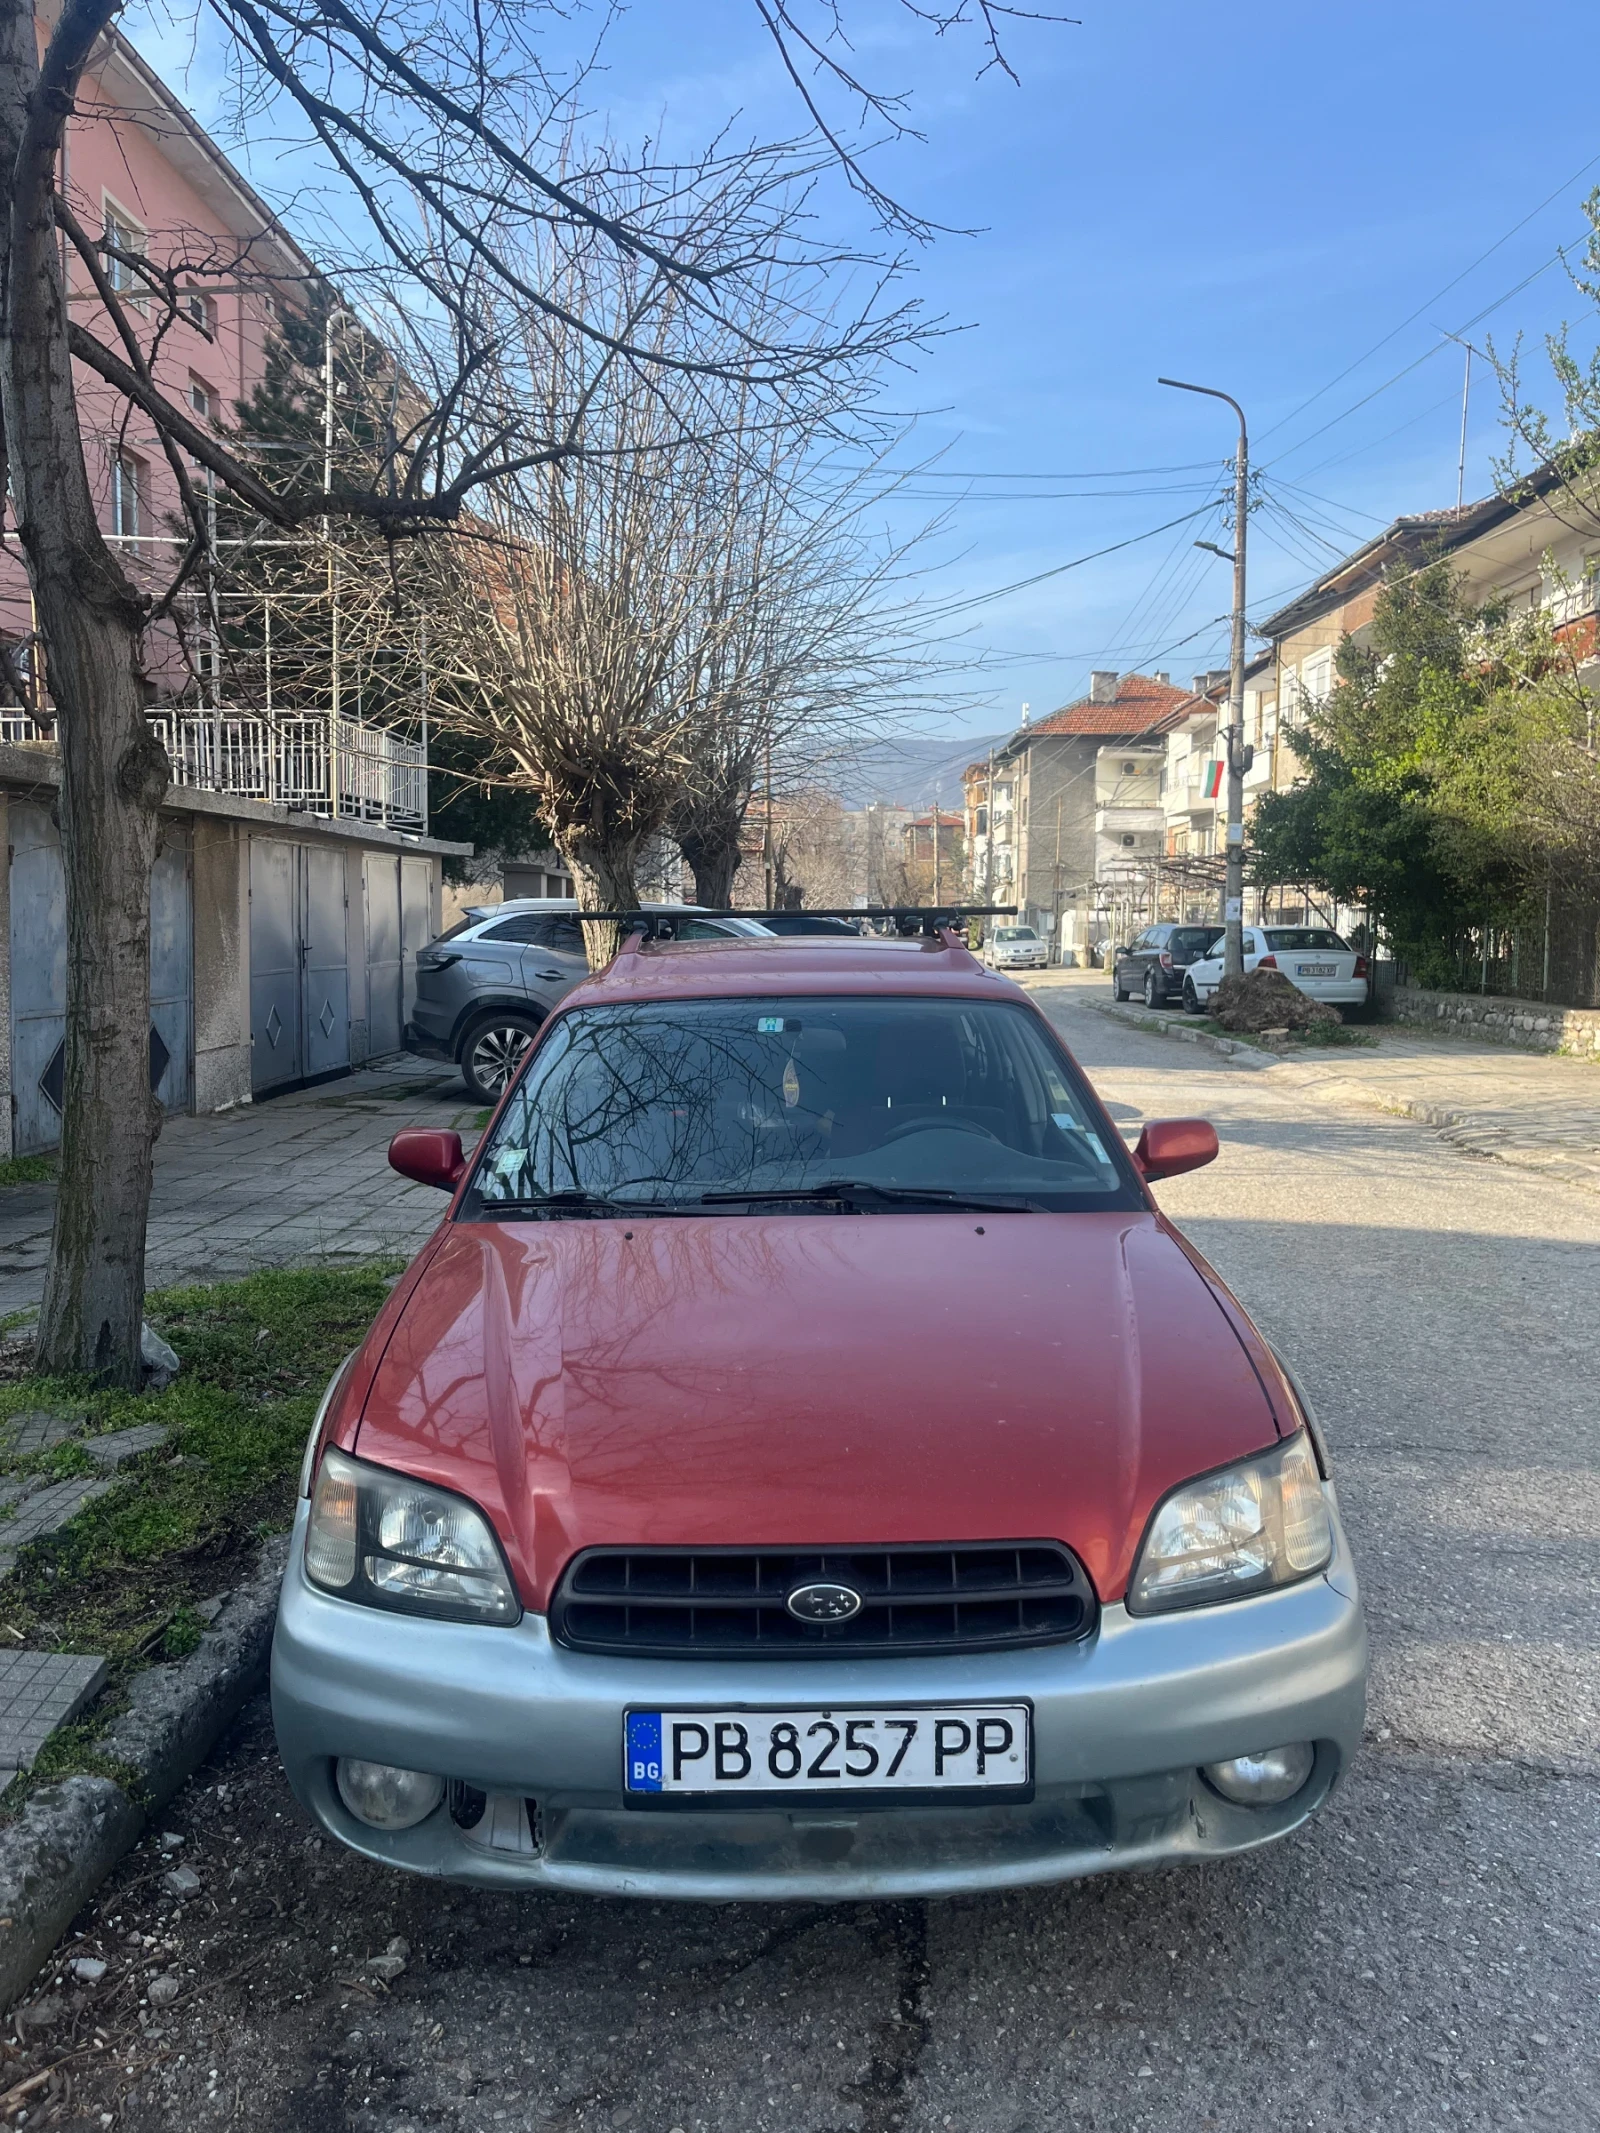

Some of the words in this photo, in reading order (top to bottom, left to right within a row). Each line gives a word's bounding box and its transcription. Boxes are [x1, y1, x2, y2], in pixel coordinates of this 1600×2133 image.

[672, 1721, 752, 1781] PB
[768, 1719, 919, 1780] 8257
[934, 1716, 1014, 1777] PP
[633, 1761, 660, 1780] BG
